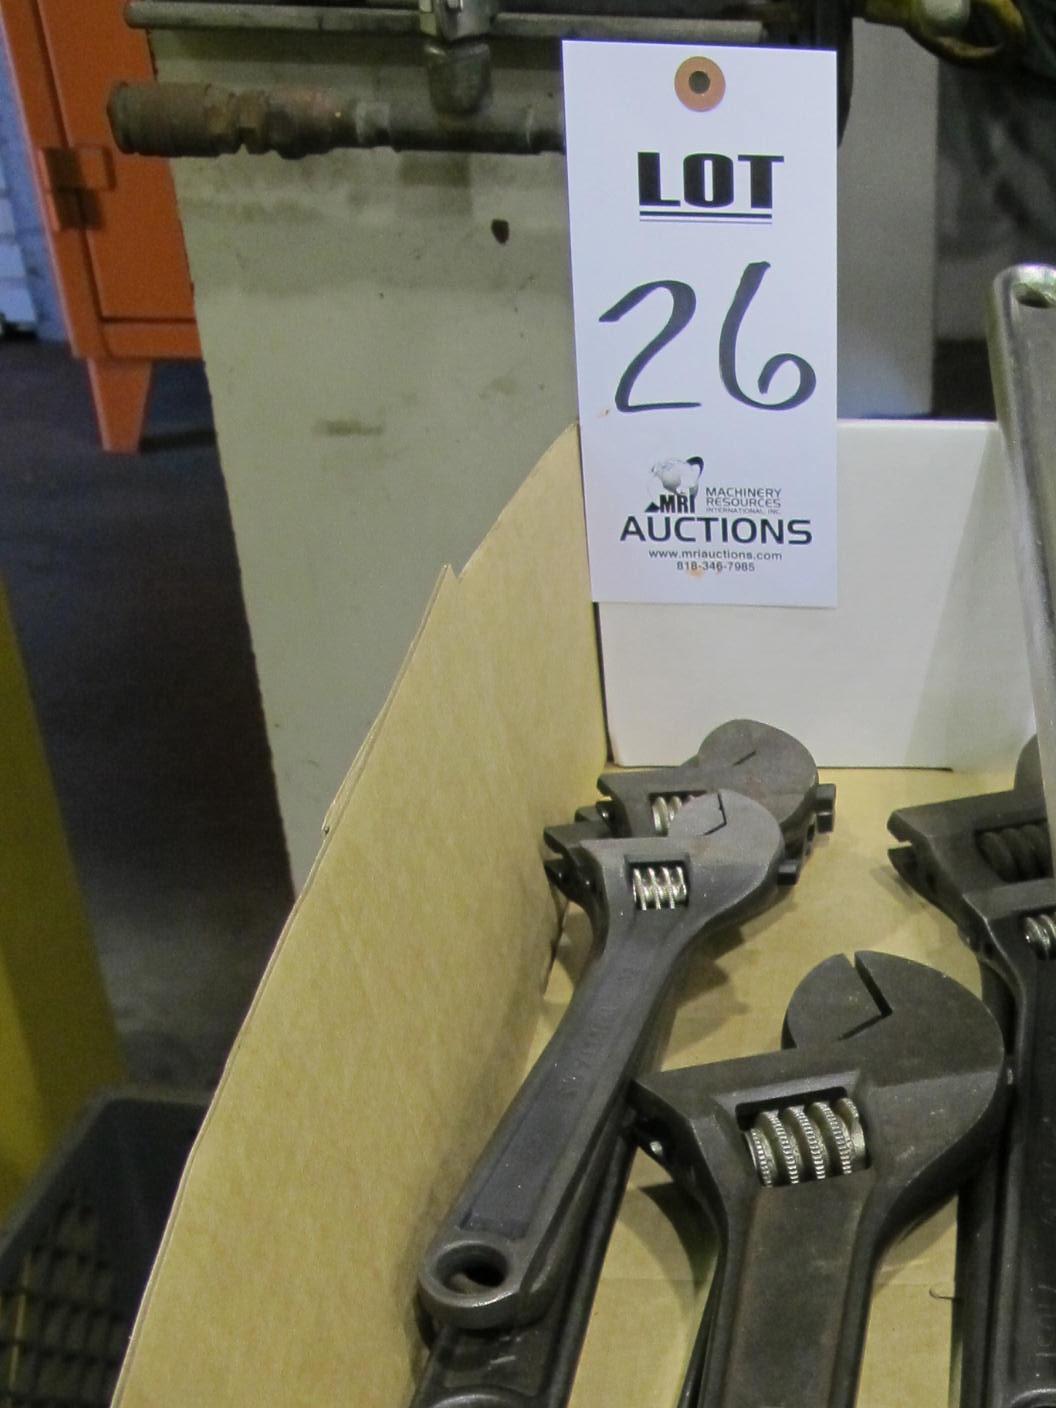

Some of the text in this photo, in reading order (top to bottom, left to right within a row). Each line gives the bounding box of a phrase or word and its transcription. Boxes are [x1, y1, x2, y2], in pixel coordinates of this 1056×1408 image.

[637, 152, 784, 209] LOT
[599, 261, 817, 412] 26
[705, 487, 782, 498] MACHINERY
[659, 494, 696, 513] MRI
[705, 498, 782, 508] RESOURCES
[620, 516, 812, 544] AUCTIONS
[649, 549, 782, 561] www.mriauctions.com
[677, 561, 755, 573] 818-346-7985
